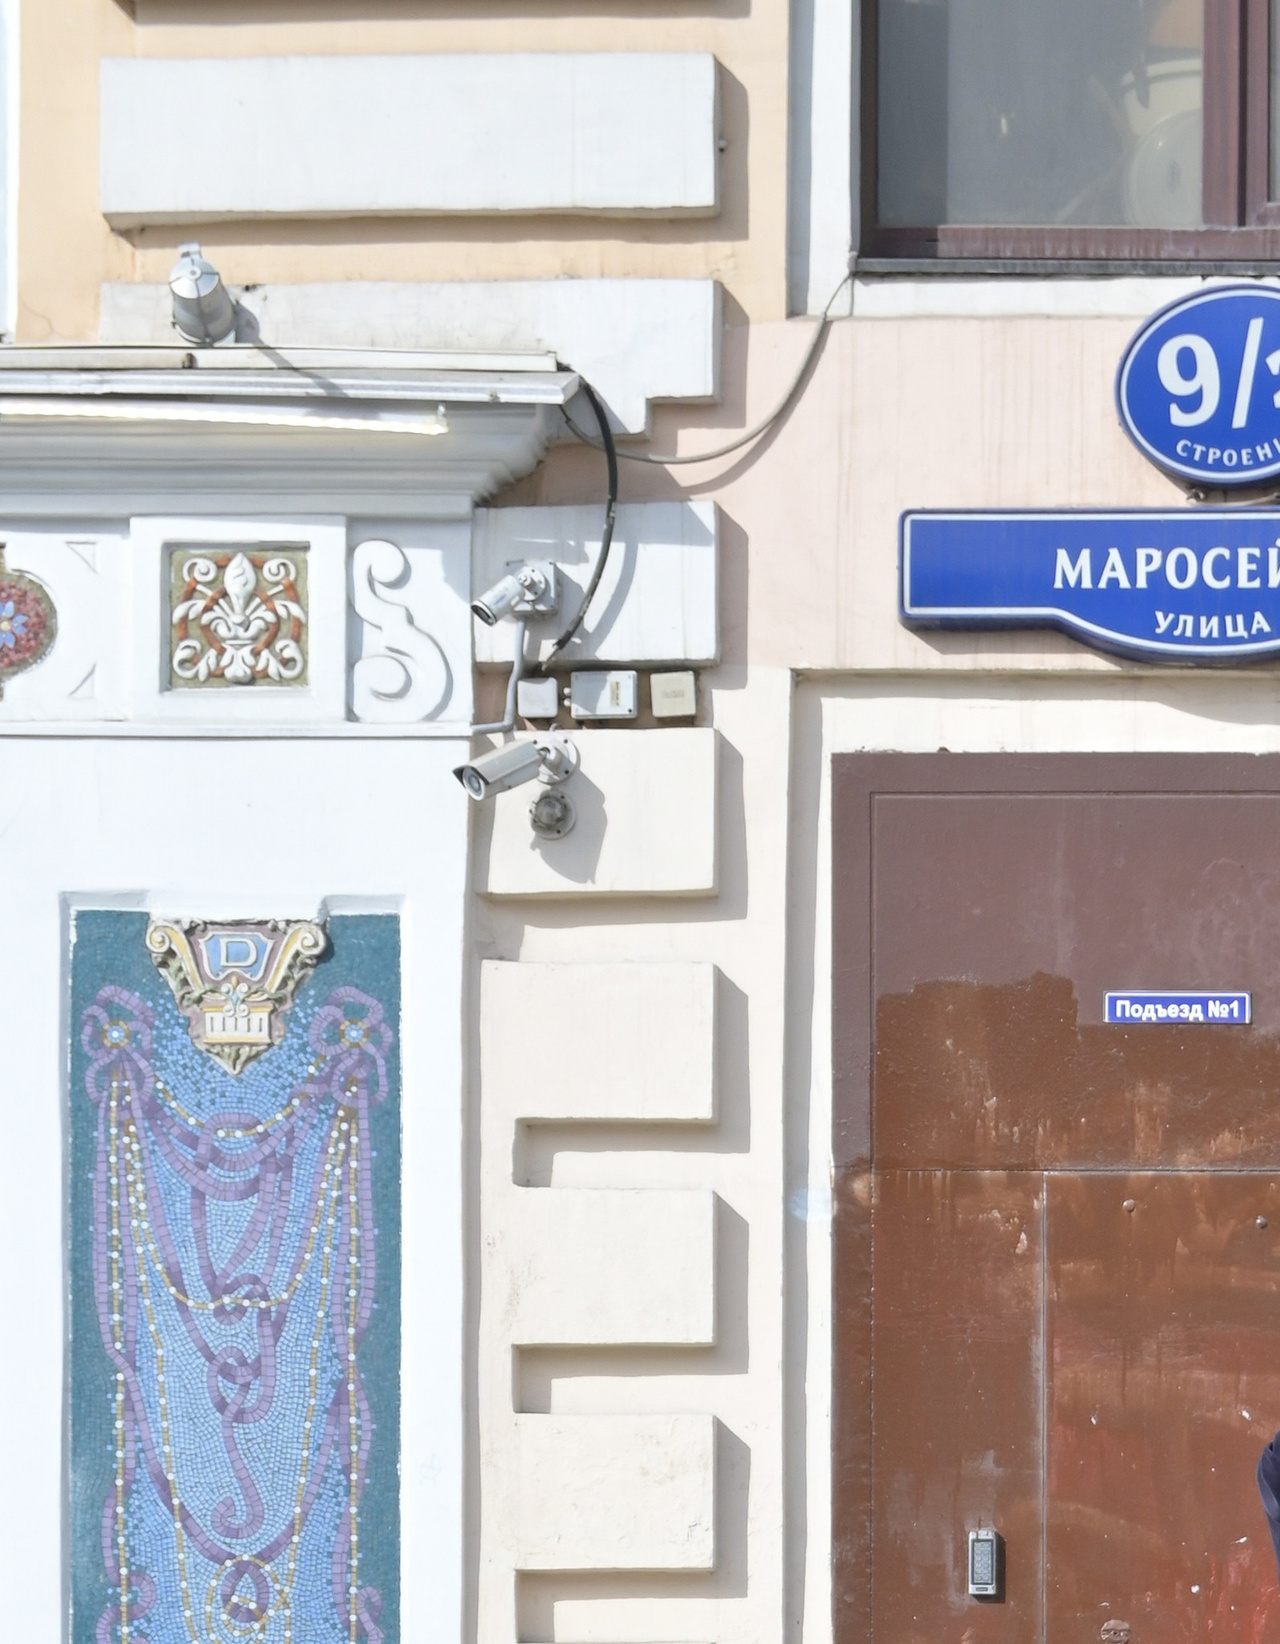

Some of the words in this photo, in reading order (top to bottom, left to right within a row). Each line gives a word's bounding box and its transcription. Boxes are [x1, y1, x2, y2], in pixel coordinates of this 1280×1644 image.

[1153, 610, 1272, 639] УЛИЦА
[1115, 999, 1204, 1022] Подъезд
[1207, 999, 1239, 1018] №1
